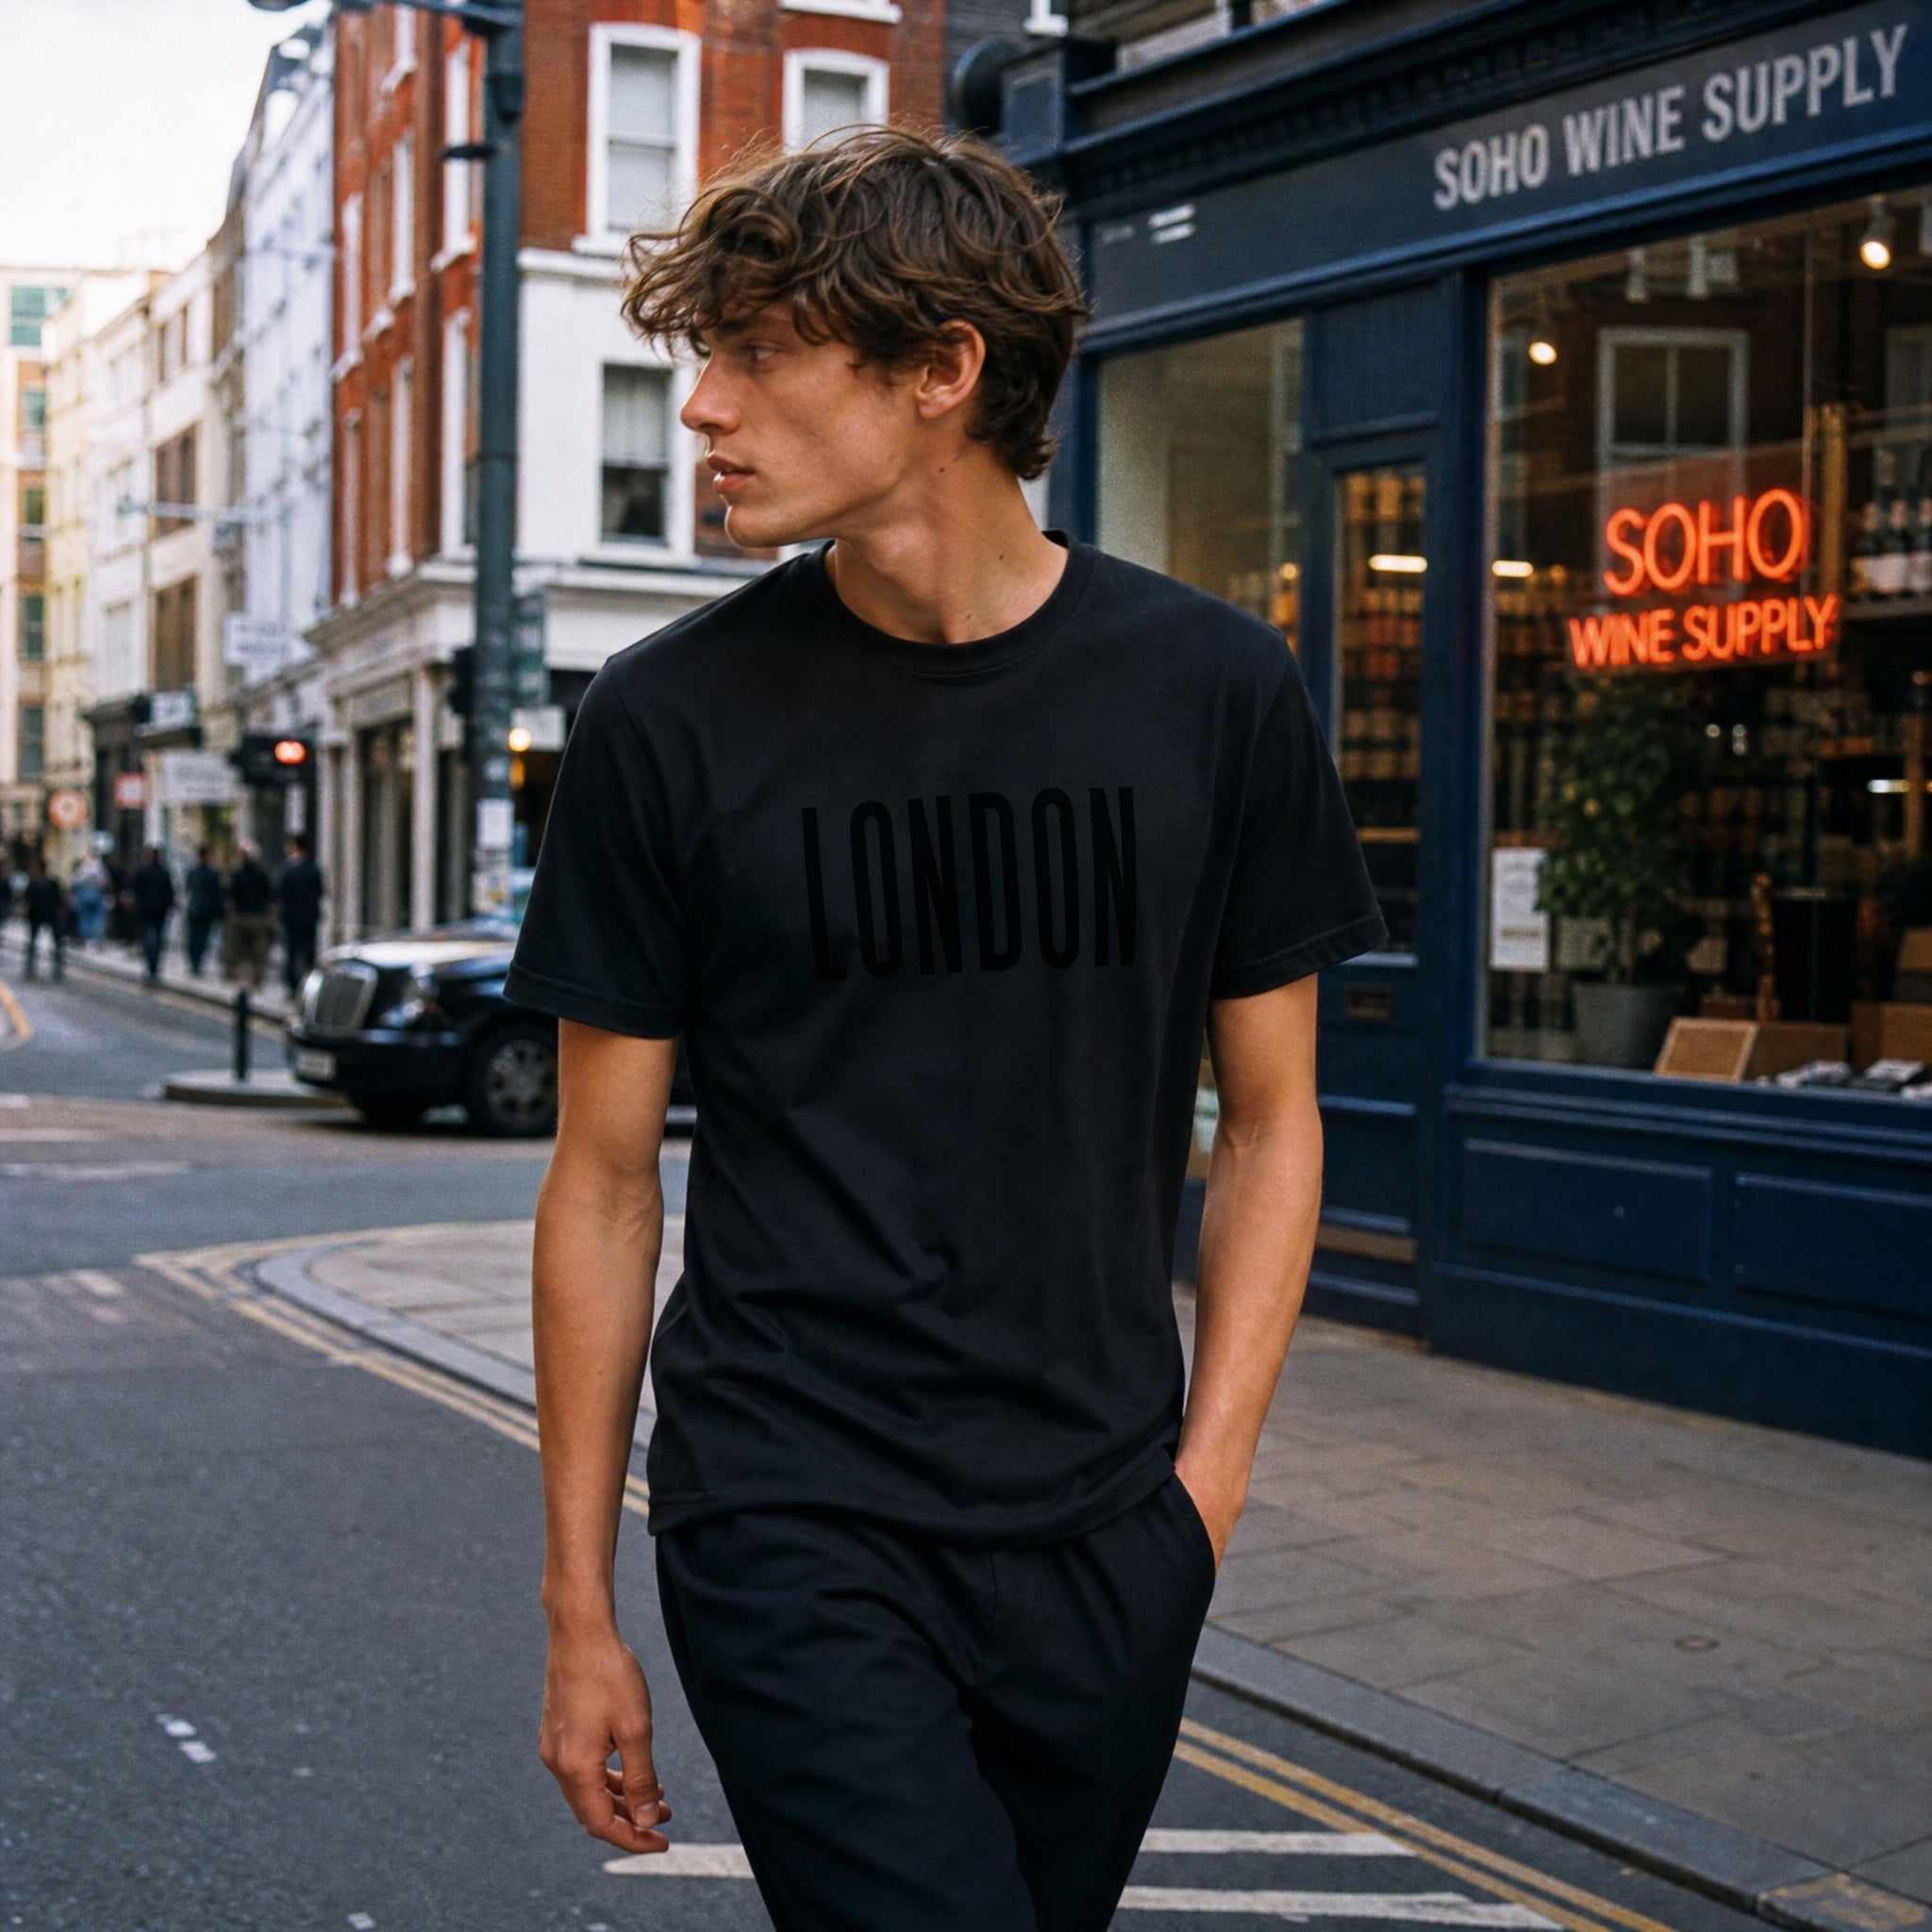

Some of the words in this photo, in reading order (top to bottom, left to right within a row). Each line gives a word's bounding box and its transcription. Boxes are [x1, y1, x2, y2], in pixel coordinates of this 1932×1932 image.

[1433, 123, 1550, 210] SOHO
[1562, 85, 1686, 177] WINE
[1701, 24, 1908, 143] SUPPLY
[1603, 488, 1806, 596] SOHO
[1569, 608, 1674, 669] WINE
[1681, 593, 1839, 661] SUPPLY
[801, 787, 1138, 981] LONDON
